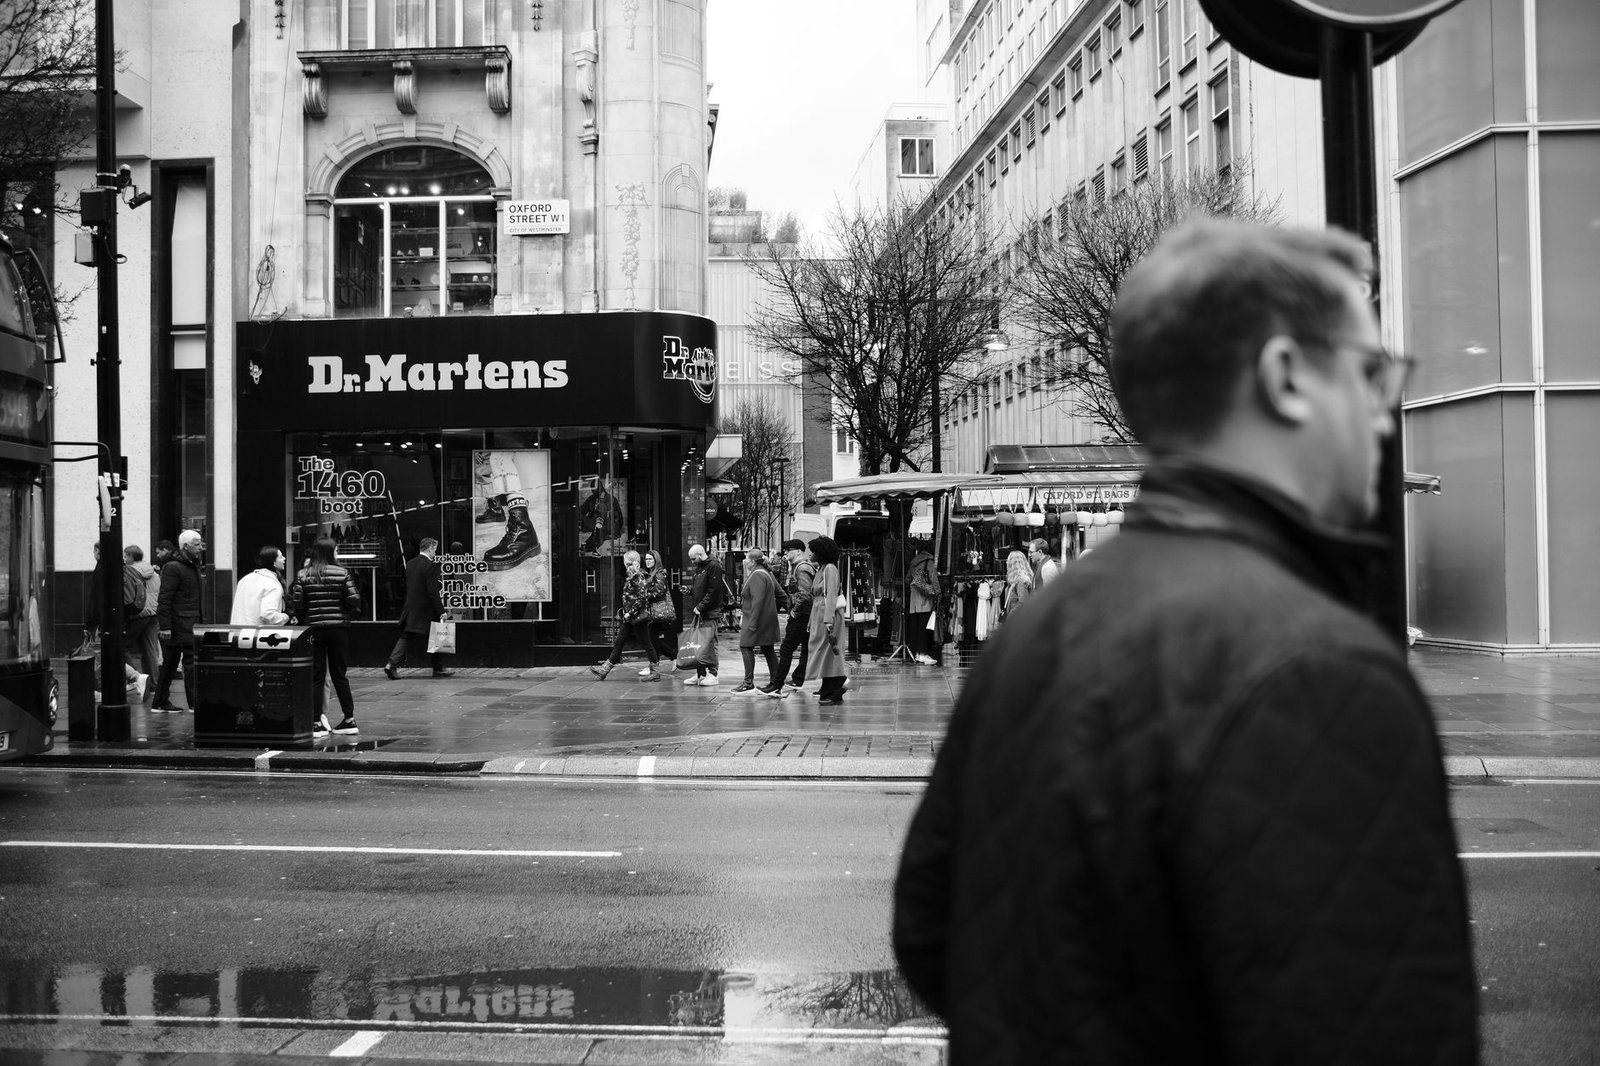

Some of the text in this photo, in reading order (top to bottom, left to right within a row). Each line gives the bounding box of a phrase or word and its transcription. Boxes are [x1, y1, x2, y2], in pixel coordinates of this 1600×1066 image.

[508, 203, 552, 213] OXFORD
[509, 214, 565, 224] STREET W1
[298, 456, 335, 471] The
[297, 470, 386, 498] 1460
[1043, 491, 1084, 500] OXFORD
[1104, 490, 1130, 499] BAGS
[320, 499, 363, 514] boot
[432, 553, 475, 563] roken in
[441, 561, 488, 574] once
[465, 583, 480, 592] for
[440, 592, 507, 609] fetime
